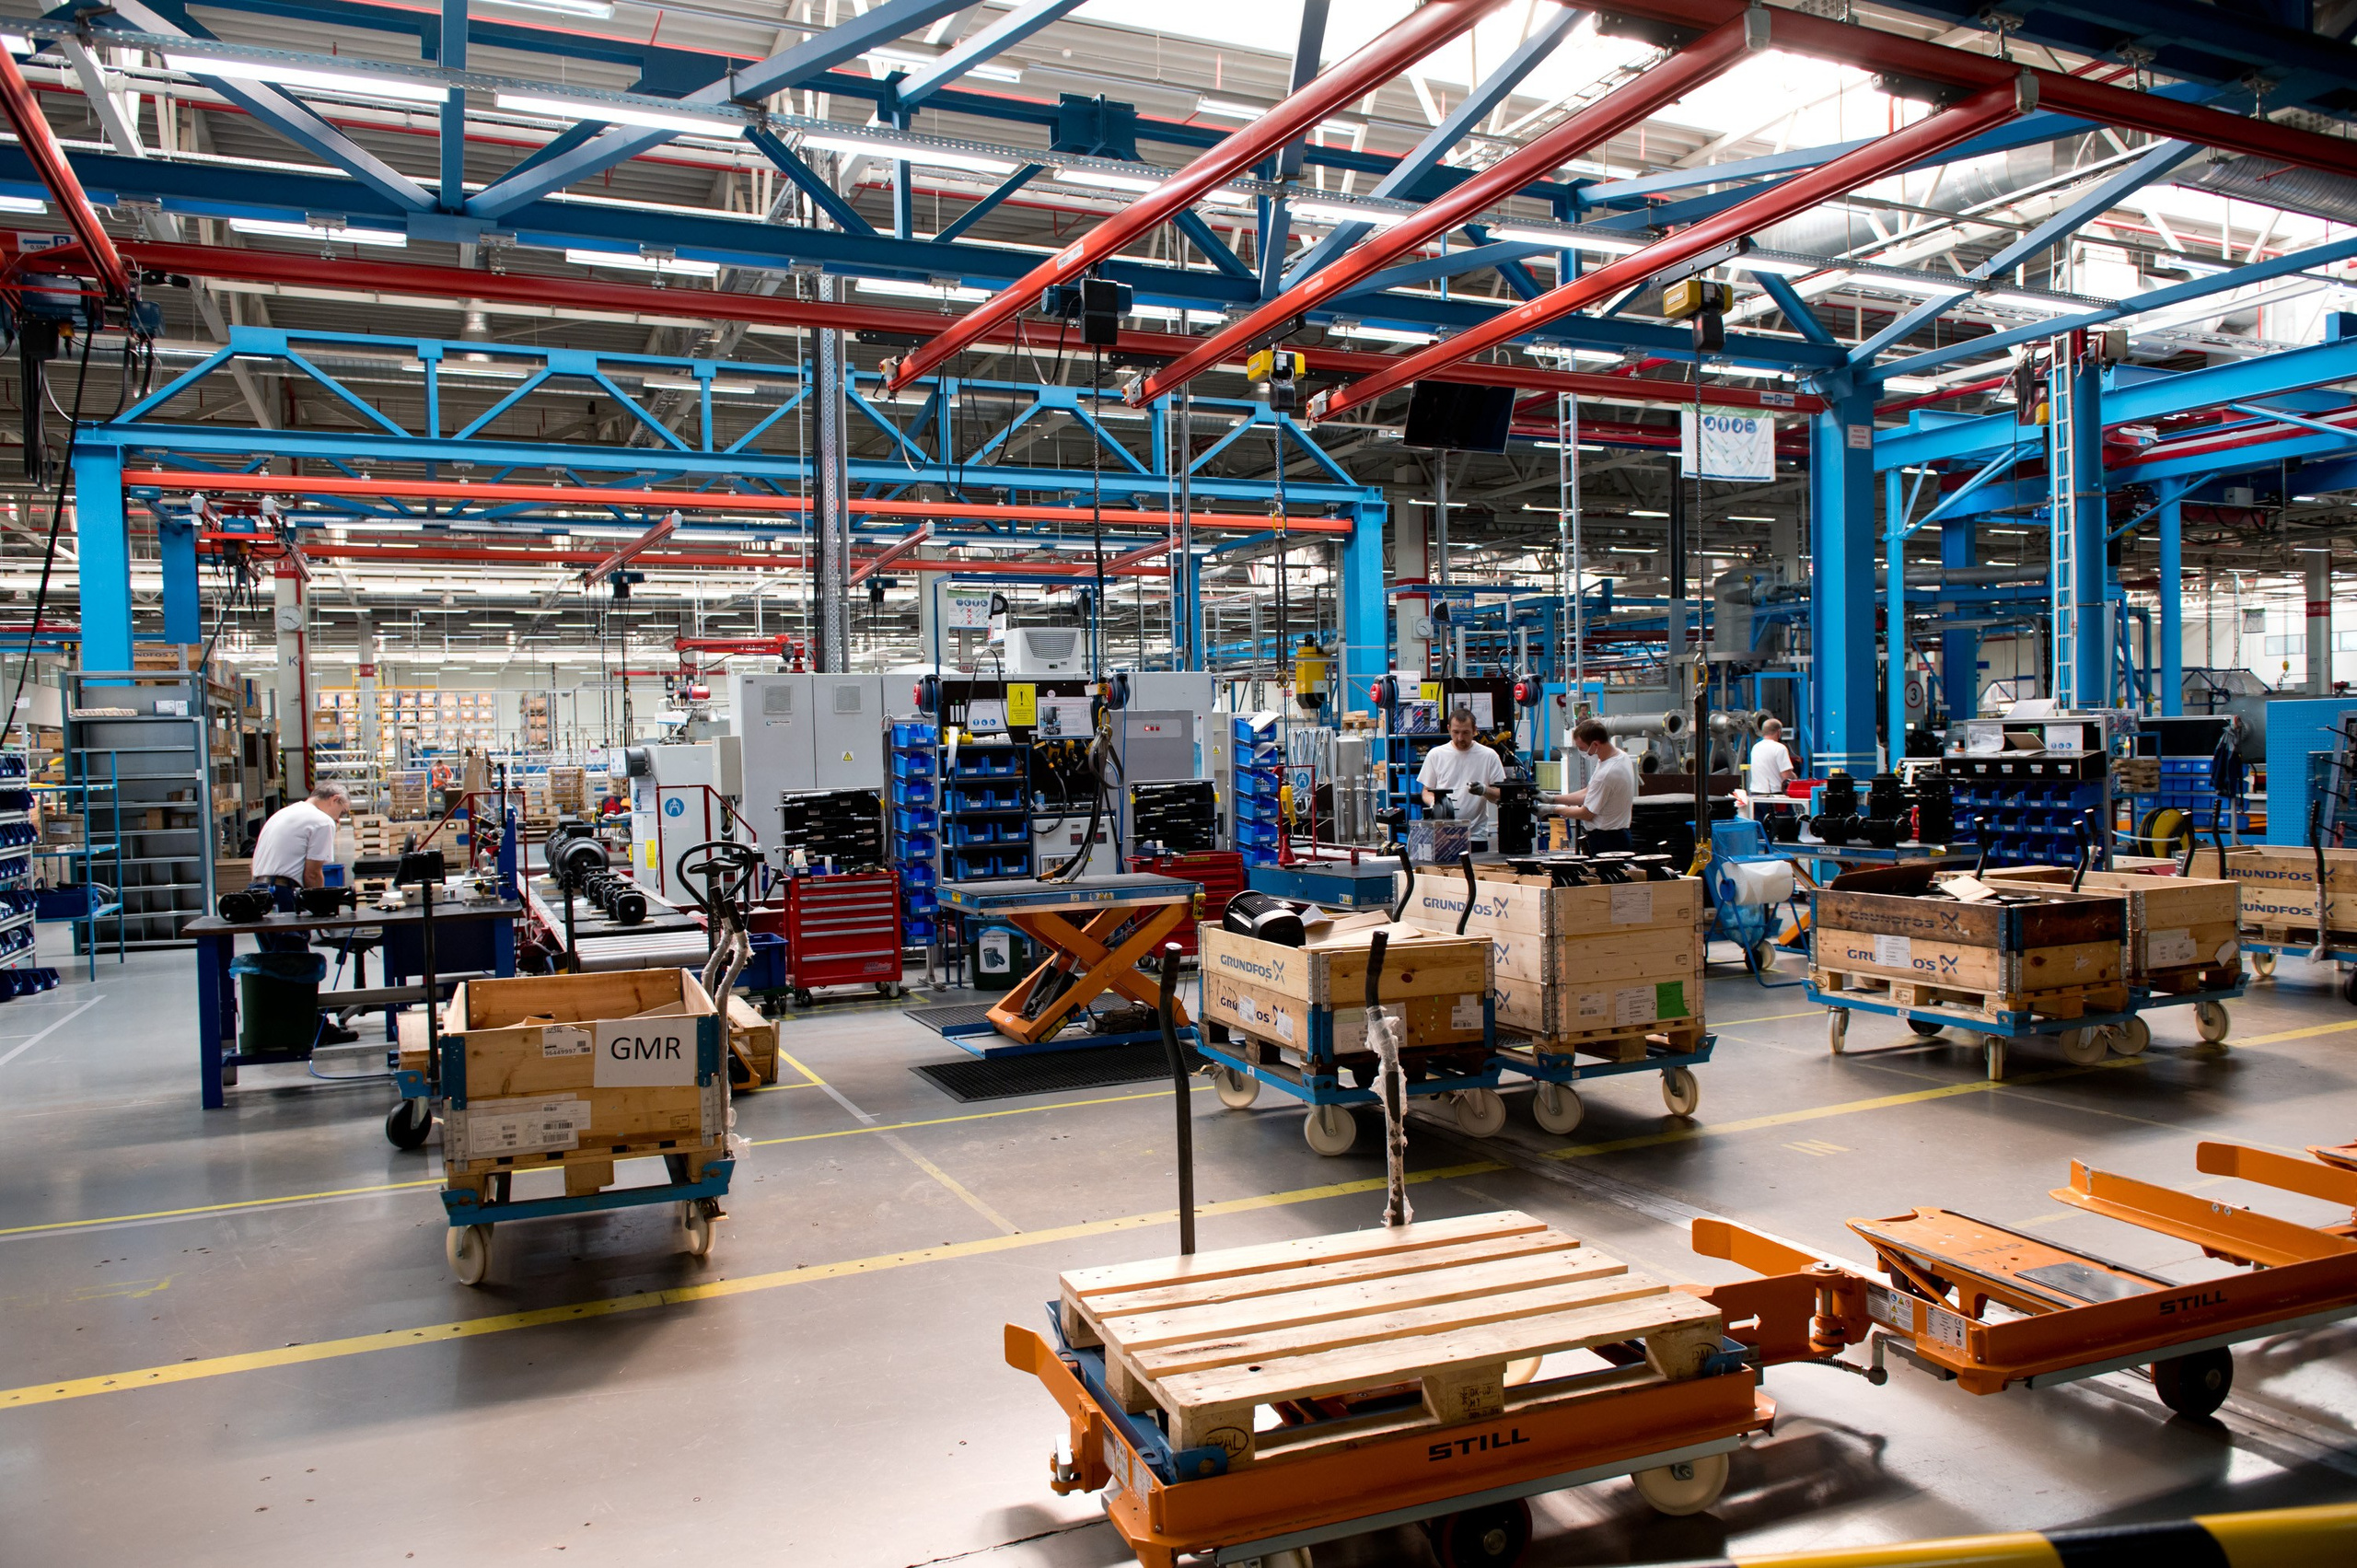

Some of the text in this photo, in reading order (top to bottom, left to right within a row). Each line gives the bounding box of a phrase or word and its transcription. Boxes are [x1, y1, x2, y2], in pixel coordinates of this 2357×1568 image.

[288, 656, 298, 667] K
[1910, 687, 1918, 702] 3
[1422, 897, 1492, 916] GRUNDOS
[1220, 954, 1272, 980] GRUNDFOS
[1847, 948, 1936, 971] GRUOS
[1220, 996, 1271, 1023] GRUOS
[544, 1048, 576, 1057] 96449997
[610, 1037, 681, 1060] GMR
[2159, 1290, 2228, 1316] STILL
[1428, 1428, 1531, 1462] STILL
